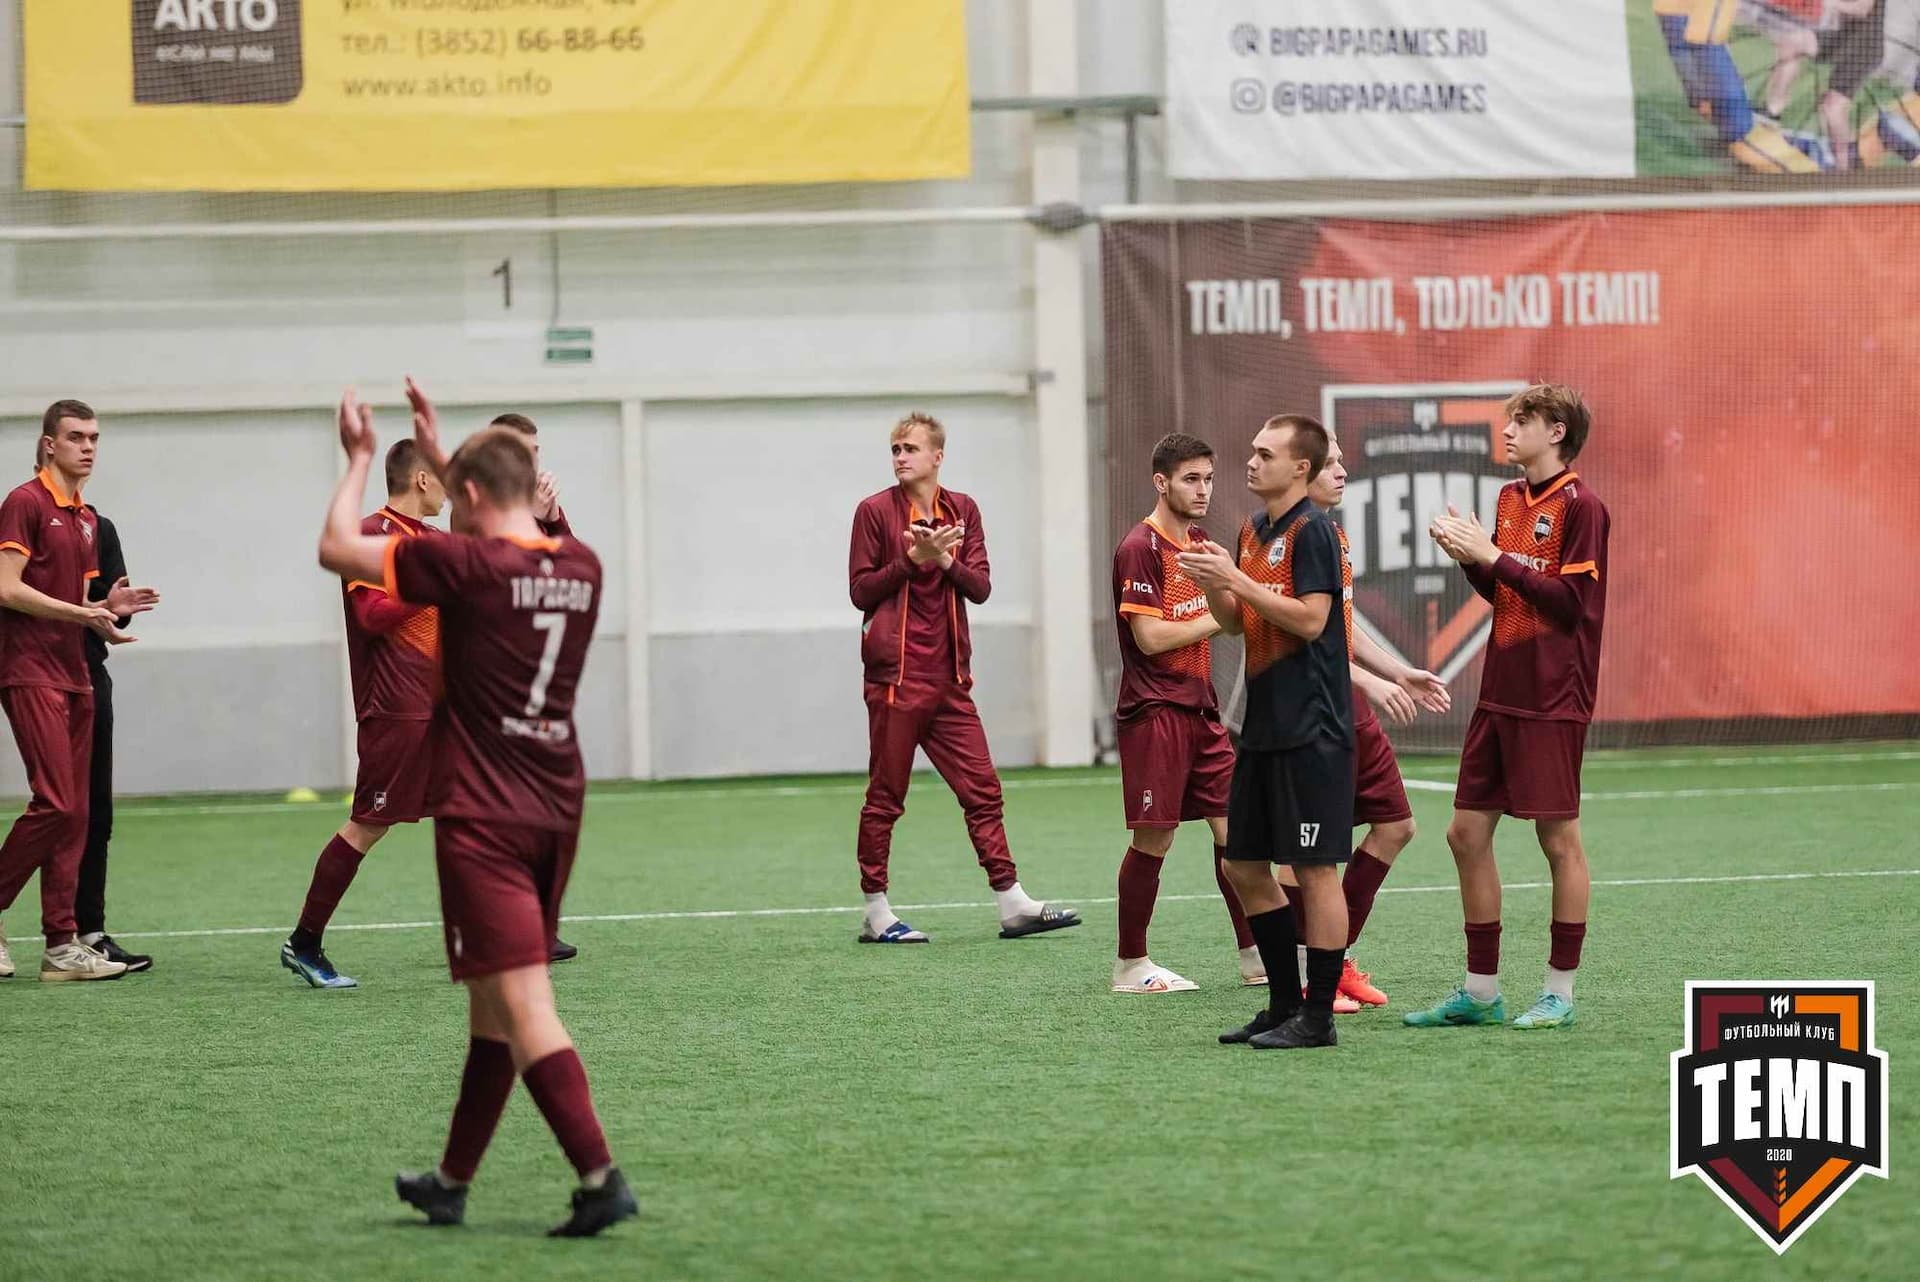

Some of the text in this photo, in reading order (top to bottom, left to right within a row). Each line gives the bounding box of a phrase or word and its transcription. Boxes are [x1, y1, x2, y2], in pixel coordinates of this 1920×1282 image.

[416, 26, 508, 59] (3852)
[516, 26, 645, 52] 66-88-66
[1270, 27, 1487, 57] BIGPAPAGAMES.RU
[341, 67, 553, 97] www.akto.info
[1272, 82, 1486, 116] @BIGPAPAGAMES
[492, 258, 511, 309] 1
[1186, 271, 1660, 339] ТЕМП, ТЕМП, ТОЛЬКО ТЕМП!
[1132, 581, 1153, 594] ПСБ
[524, 612, 567, 716] 7
[1300, 822, 1320, 847] 57
